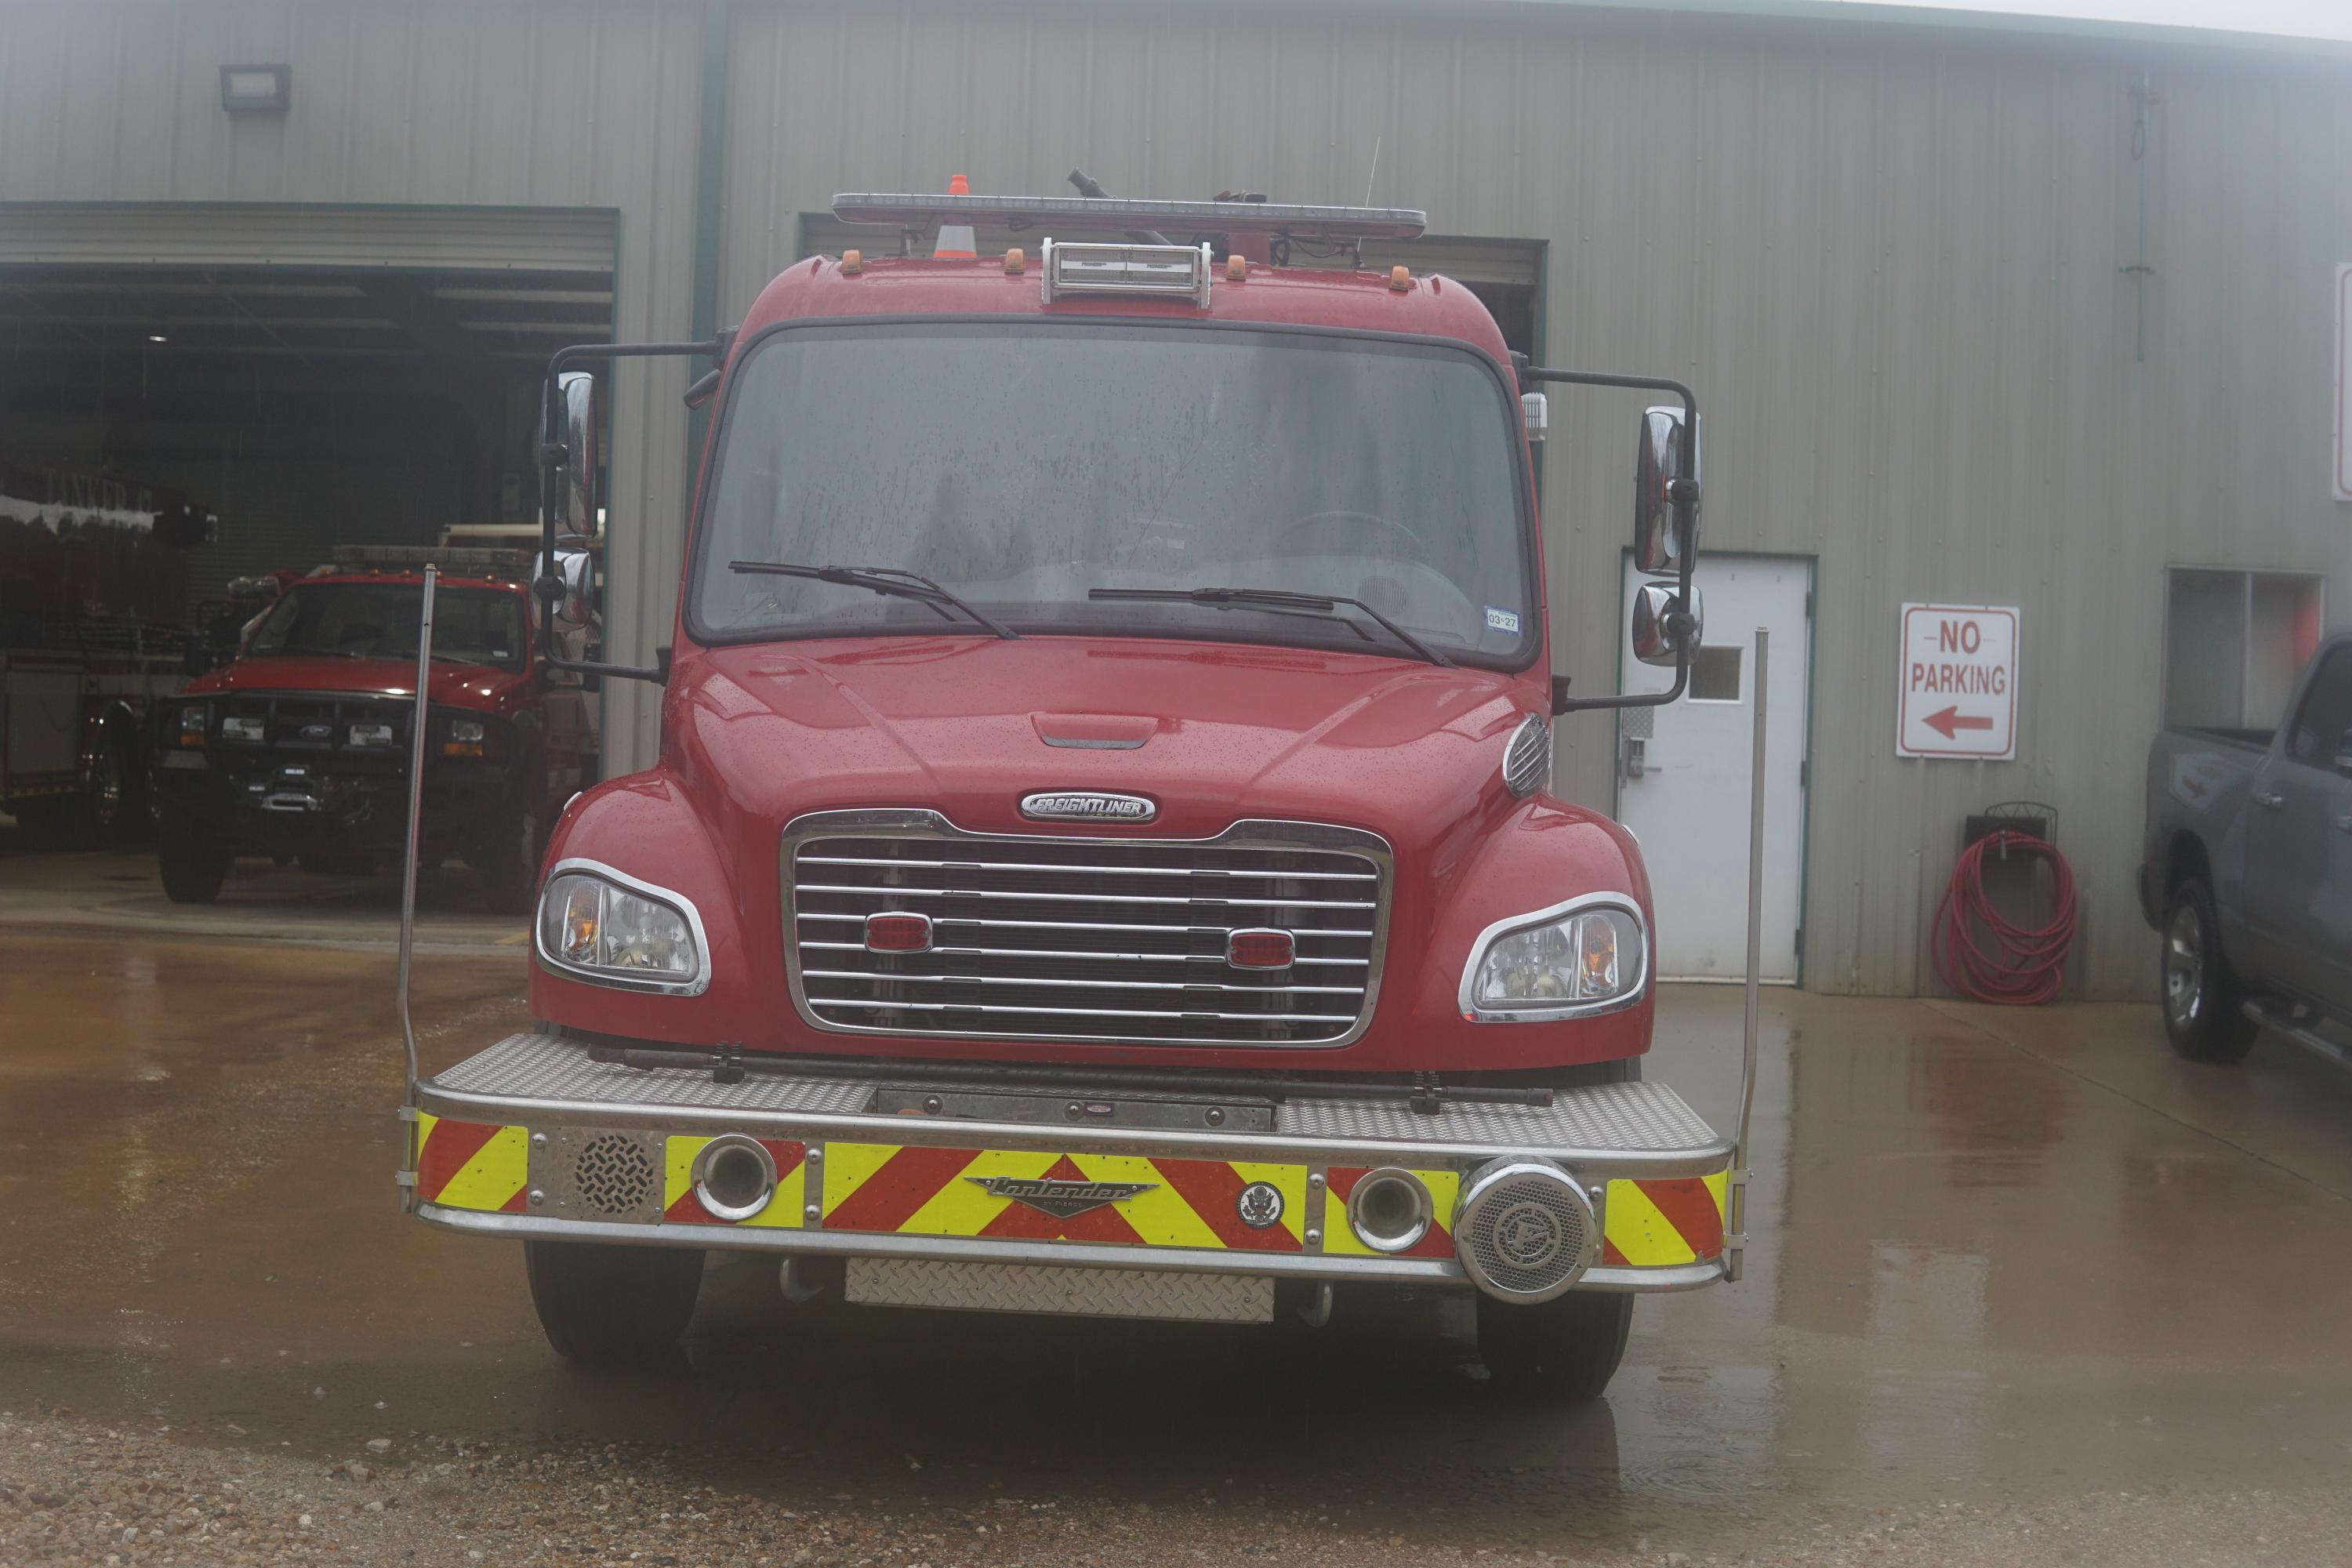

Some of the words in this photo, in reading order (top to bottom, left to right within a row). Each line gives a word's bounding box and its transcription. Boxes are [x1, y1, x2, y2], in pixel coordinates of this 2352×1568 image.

[1940, 619, 1981, 654] NO
[1911, 662, 2006, 696] PARKING
[1035, 797, 1142, 815] FREIGHTLINER
[986, 1175, 1132, 1201] Contender
